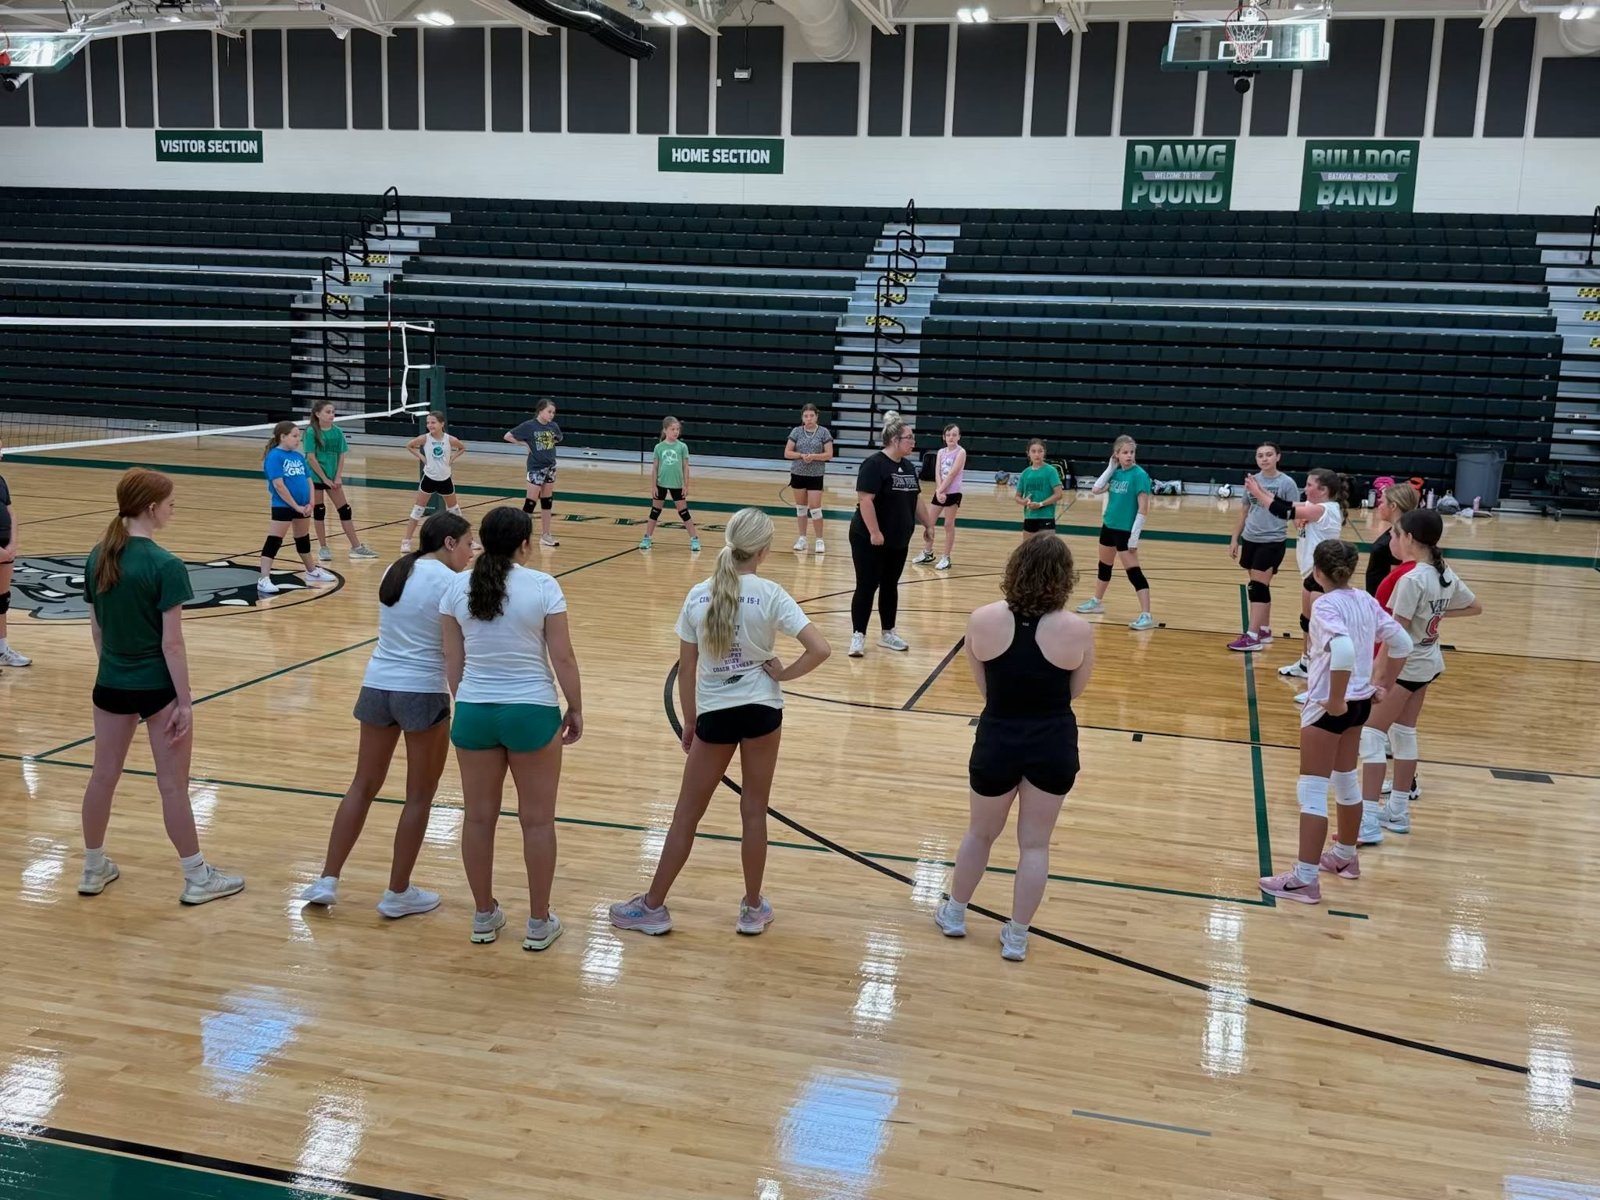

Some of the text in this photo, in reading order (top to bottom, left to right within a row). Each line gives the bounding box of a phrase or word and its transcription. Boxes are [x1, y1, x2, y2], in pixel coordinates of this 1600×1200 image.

[160, 139, 258, 154] VISITOR SECTION
[671, 148, 770, 164] HOME SECTION
[1134, 144, 1227, 170] DAWG
[1311, 149, 1411, 168] BULLDOG
[1154, 171, 1181, 180] WELCOME
[1131, 180, 1223, 204] POUND
[1316, 181, 1398, 206] BAND
